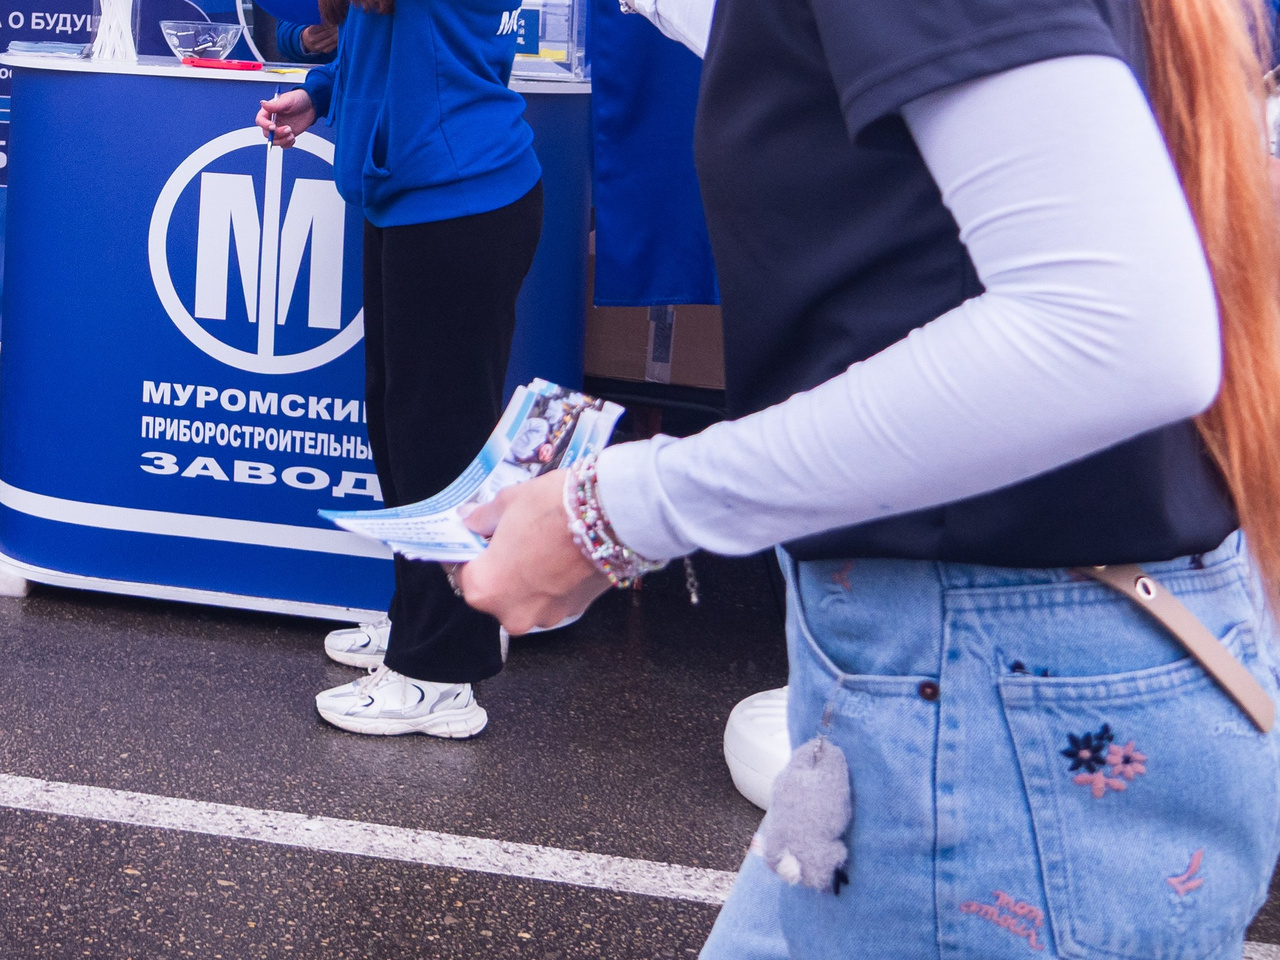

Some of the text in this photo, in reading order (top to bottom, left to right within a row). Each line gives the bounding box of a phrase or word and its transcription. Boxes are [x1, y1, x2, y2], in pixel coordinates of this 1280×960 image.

[8, 11, 24, 29] О
[142, 380, 367, 424] МУРОМСКИ
[140, 451, 384, 502] ЗАВОД
